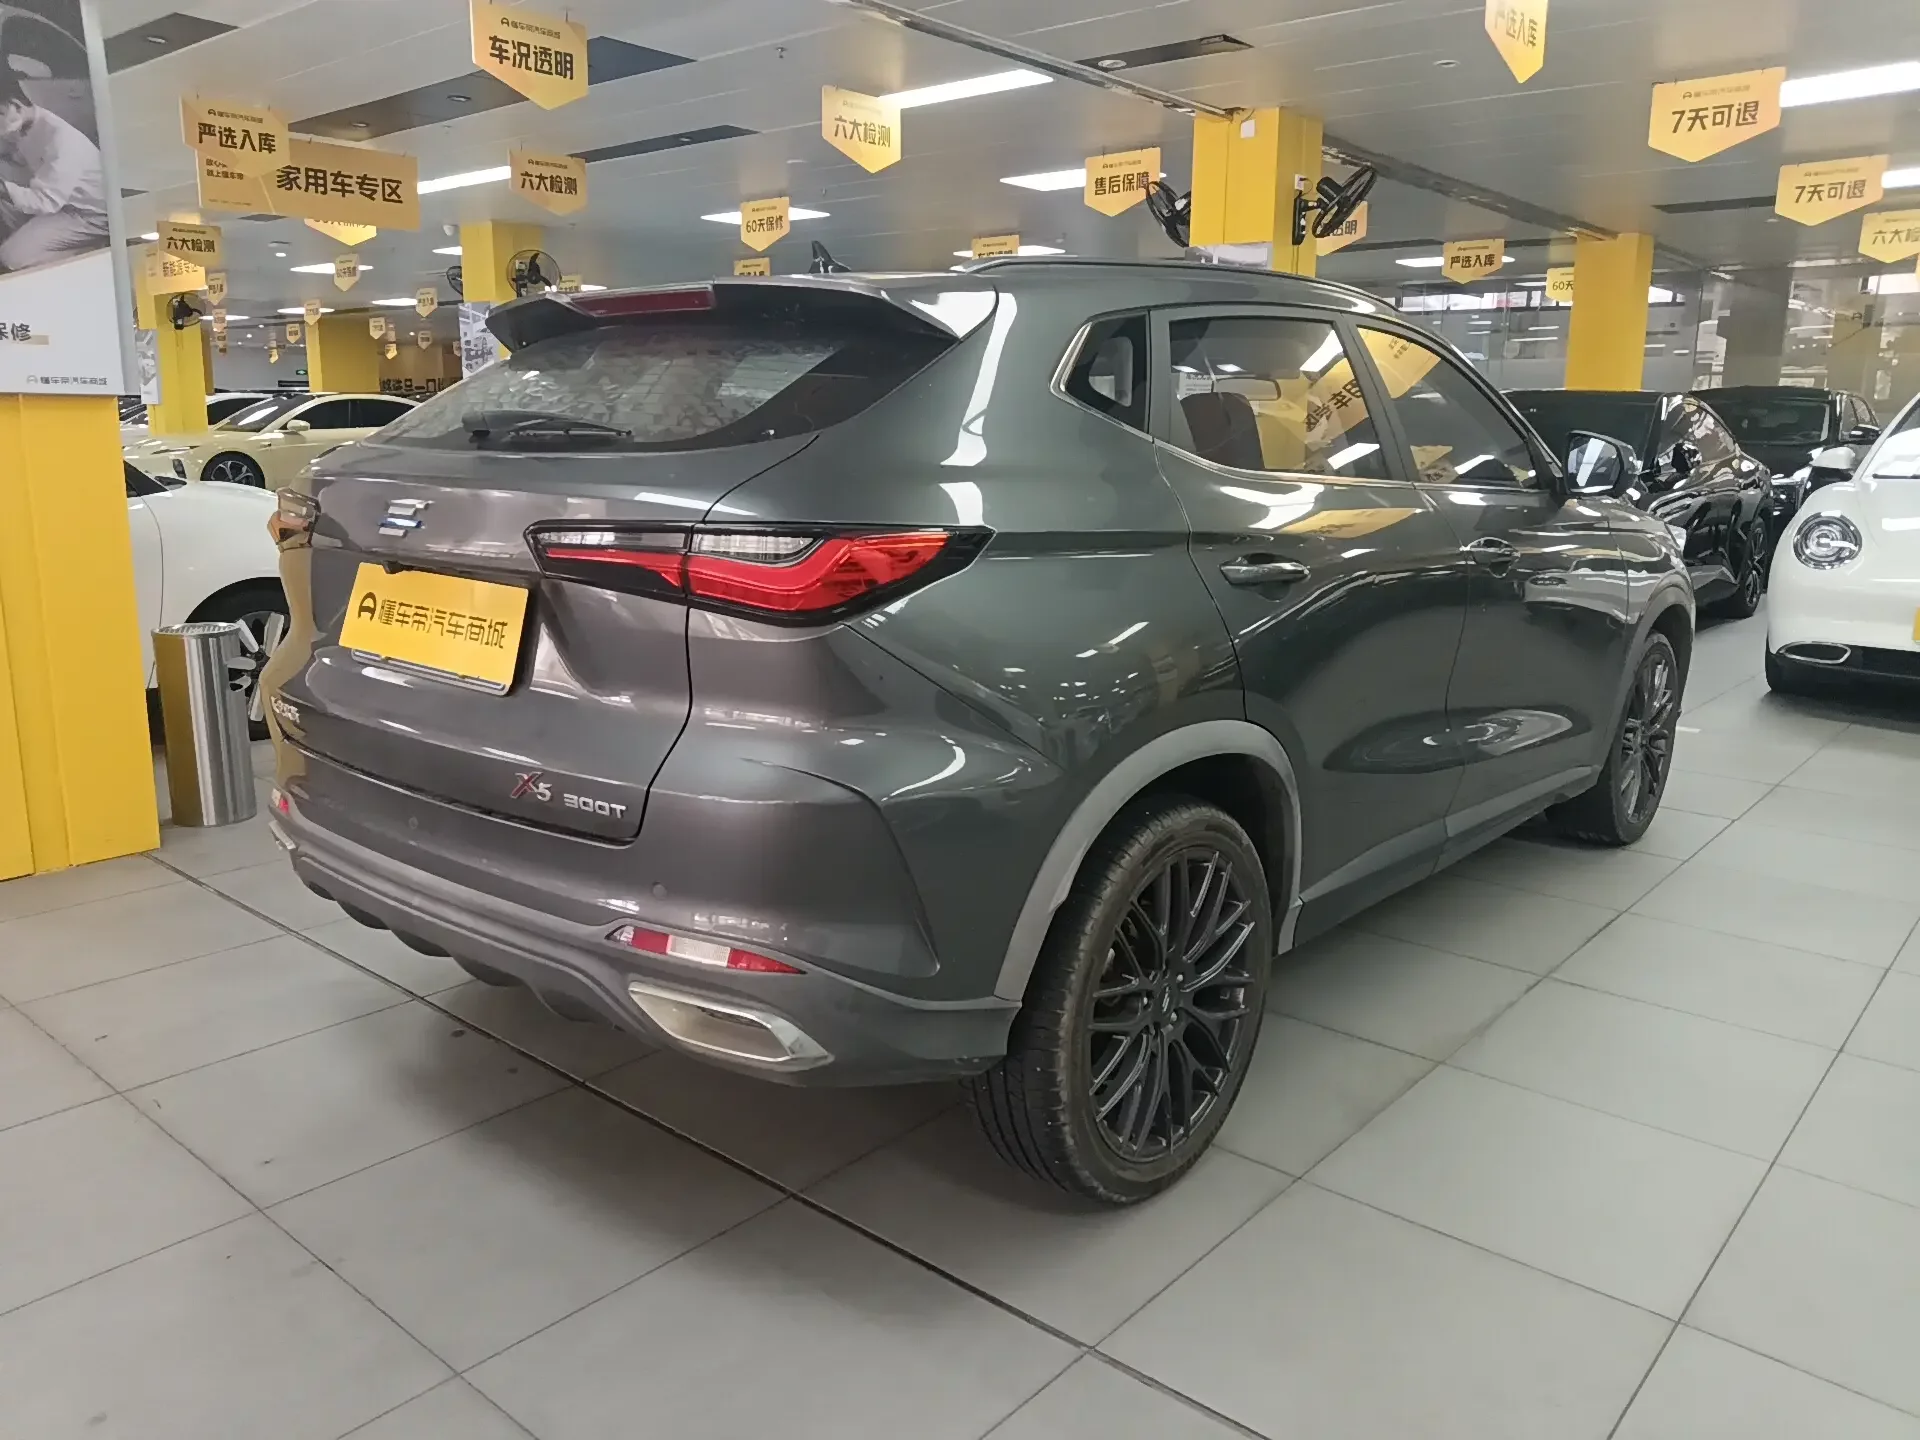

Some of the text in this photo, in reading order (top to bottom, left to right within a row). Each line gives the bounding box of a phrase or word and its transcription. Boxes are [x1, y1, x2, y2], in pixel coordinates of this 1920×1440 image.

[489, 35, 574, 80] 车况透明
[834, 114, 891, 148] 六大检测
[1671, 100, 1759, 134] 7天可退
[198, 122, 277, 154] 严选入库
[276, 165, 404, 204] 家用车专区
[520, 171, 578, 195] 六大检测
[1095, 171, 1150, 196] 售后保障
[1794, 179, 1867, 204] 7天可退
[746, 214, 784, 234] 60天保修
[166, 236, 216, 253] 六大检测
[1450, 253, 1496, 269] 严选入库
[378, 598, 509, 649] 懂车帝汽车商城
[510, 771, 627, 819] X5 300T
